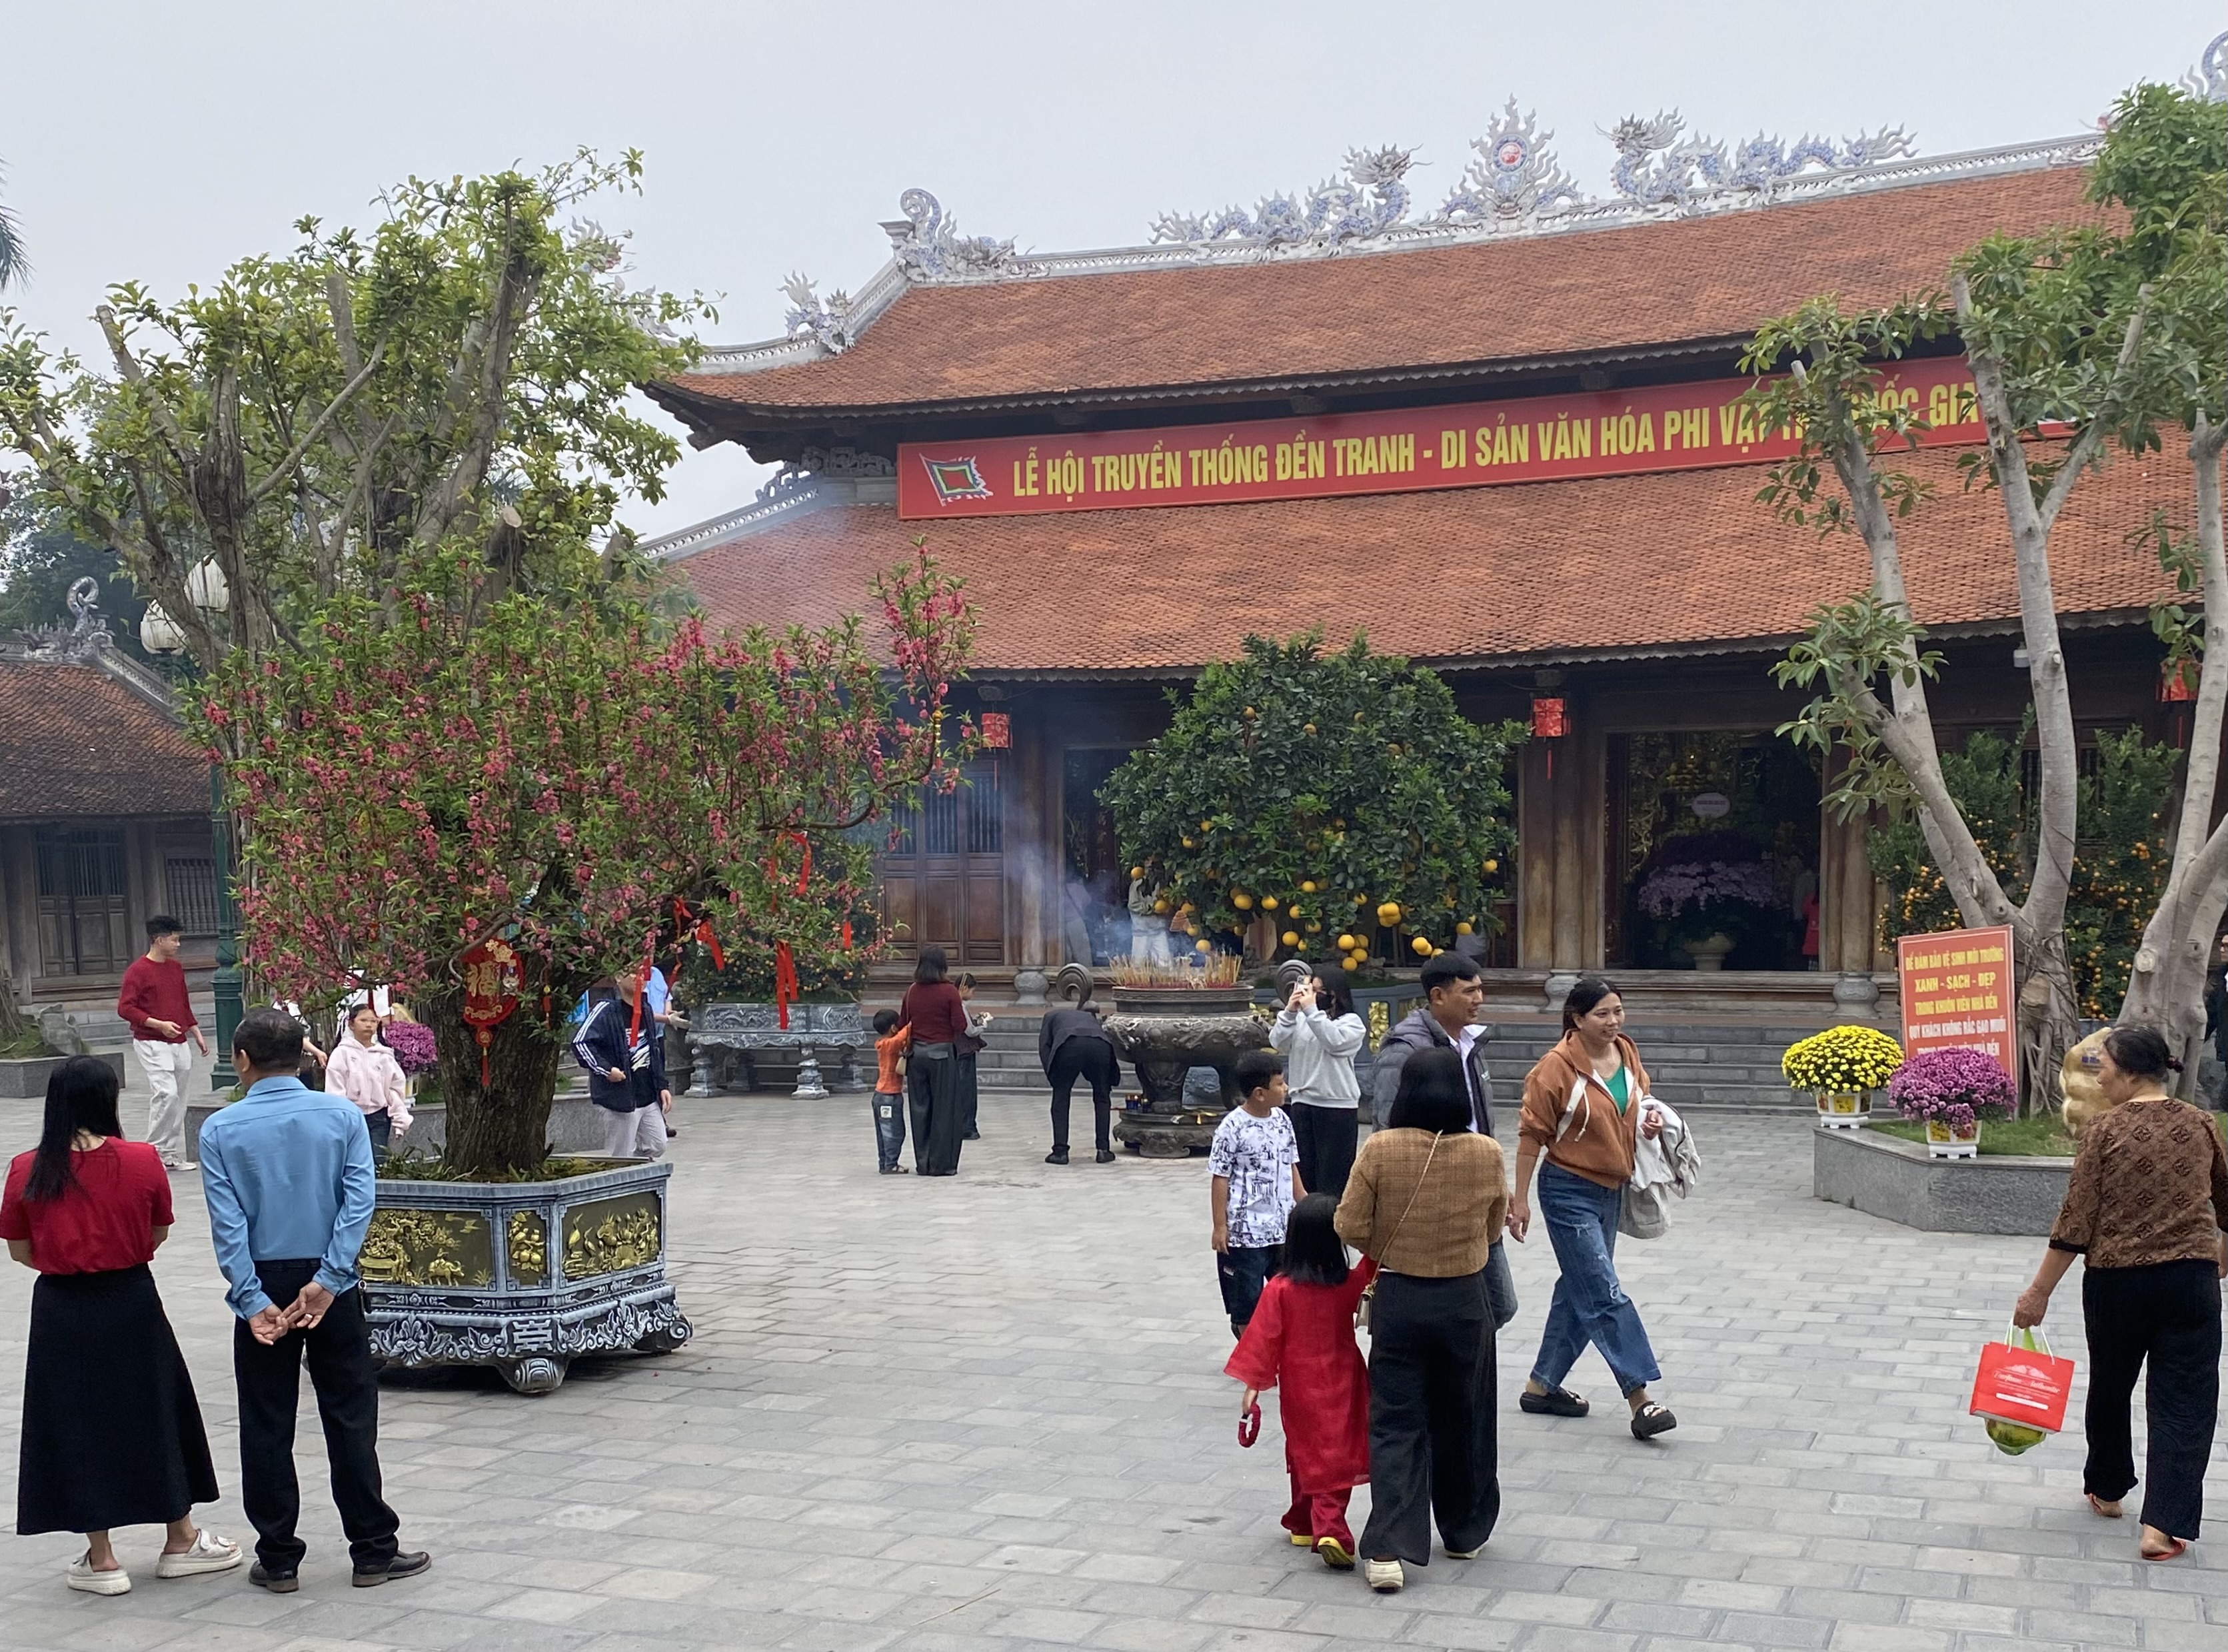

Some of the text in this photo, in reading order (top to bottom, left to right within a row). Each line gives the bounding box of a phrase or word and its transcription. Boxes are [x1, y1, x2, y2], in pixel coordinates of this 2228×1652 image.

[1013, 445, 1038, 497] LỄ
[1046, 450, 1084, 502] HỘI
[1092, 439, 1182, 492] TRUYỀN
[1189, 432, 1268, 487] THỐNG
[1276, 429, 1325, 481] ĐỀN
[1333, 434, 1414, 476] TRANH
[1441, 430, 1466, 469] DI
[1475, 411, 1529, 467] SẢN
[1538, 412, 1591, 462] VĂN
[1600, 405, 1655, 456] HÓA
[1664, 408, 1709, 450] PHI
[1914, 977, 1939, 993] XANH
[1946, 974, 1970, 992] SẠCH
[1978, 972, 1996, 990] ĐẸP
